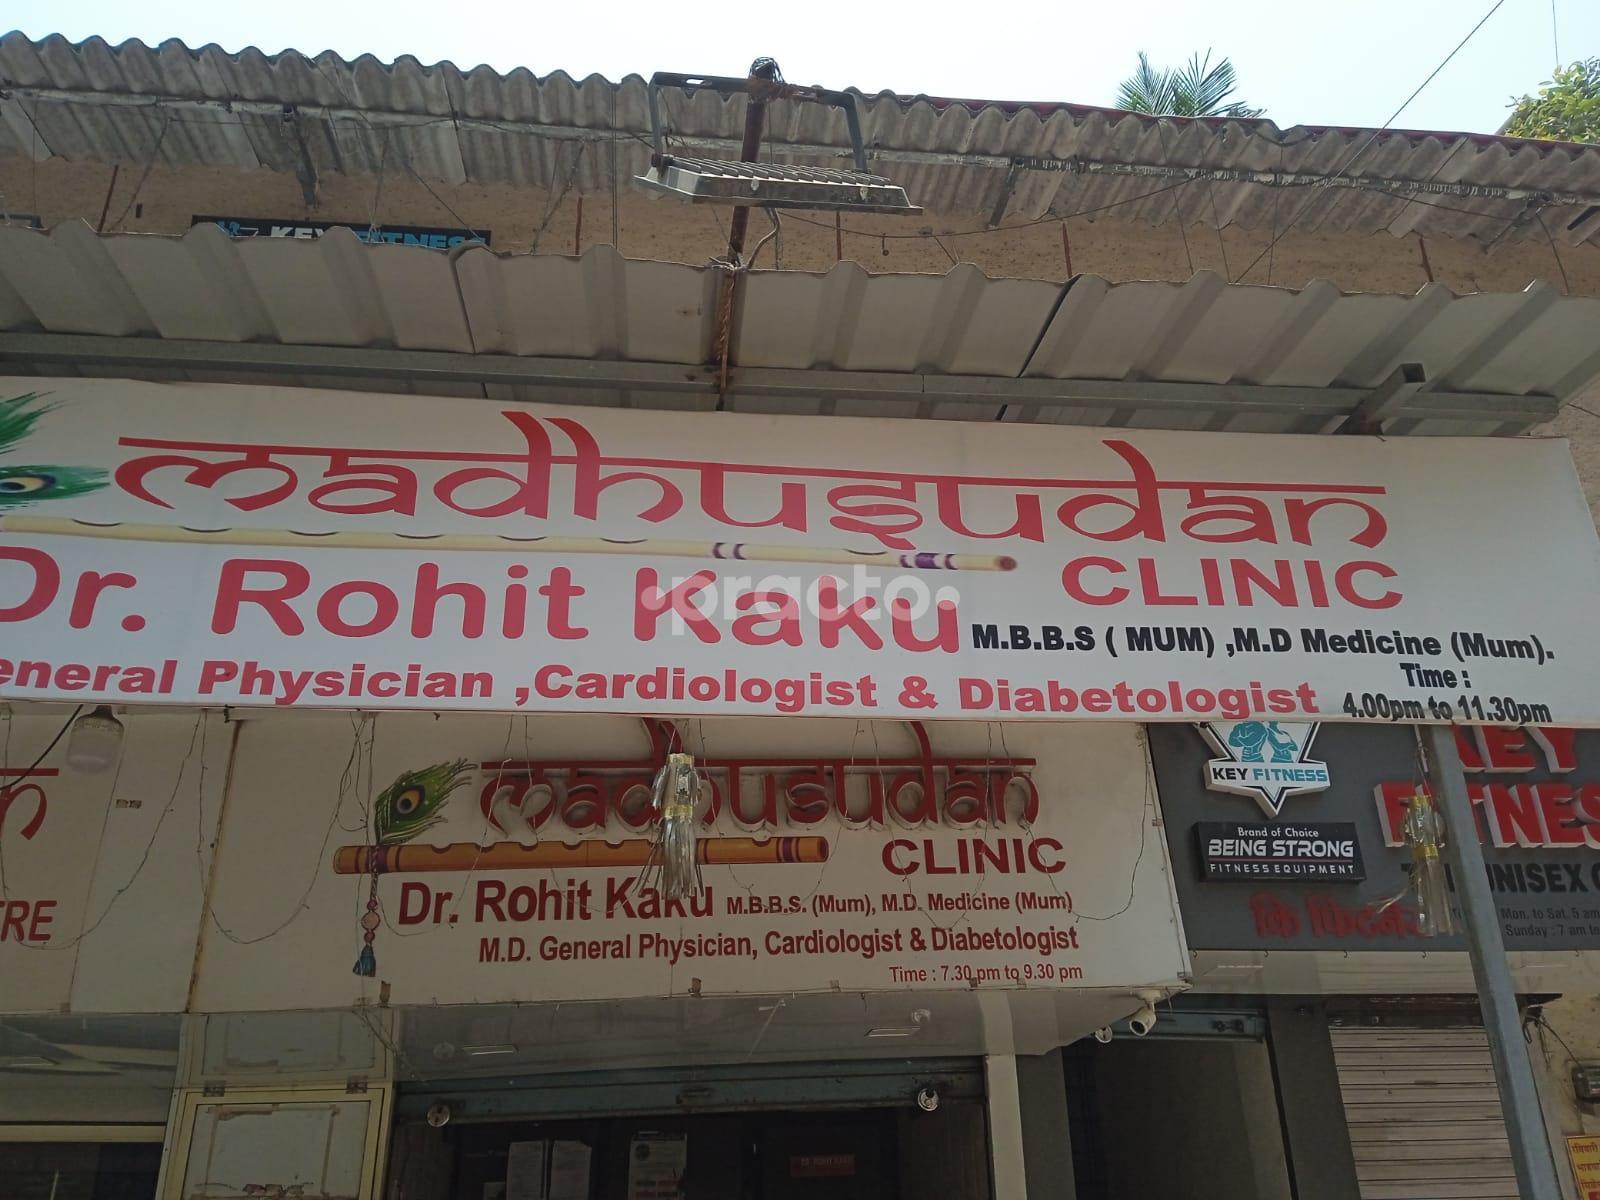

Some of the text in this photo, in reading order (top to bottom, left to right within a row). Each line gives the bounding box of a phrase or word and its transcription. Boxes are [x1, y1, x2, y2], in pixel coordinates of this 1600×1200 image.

[115, 411, 1387, 549] madhusudan
[0, 545, 960, 653] Dr. Rohit Kaku
[1062, 556, 1403, 610] CLINIC
[972, 624, 1095, 650] M.B.B.S
[1300, 628, 1442, 656] Medicine
[1450, 631, 1555, 665] (Mum).
[198, 660, 493, 705] Physician
[898, 676, 938, 709] &
[958, 677, 1320, 720] Diabetologist
[1400, 663, 1457, 688] Time
[1342, 692, 1553, 725] 4.00pm to 11.30pm
[1212, 768, 1328, 782] KEY FITNESS
[1208, 839, 1354, 857] BEING STRONG
[1238, 827, 1319, 838] Brand of Choice
[881, 836, 1067, 875] CLINIC
[1210, 863, 1354, 874] FITNESS EQUIPMENT
[398, 881, 458, 925] Dr.
[474, 878, 592, 923] Rohit
[726, 891, 1073, 917] M.B.B.S. (Mum), M.D. Medicine (Mum)
[1532, 908, 1544, 920] to
[1571, 908, 1580, 920] 5
[0, 900, 57, 942] RE
[1504, 924, 1547, 938] Sunday
[1557, 924, 1565, 936] 7
[1569, 926, 1587, 937] am
[479, 925, 1079, 966] M.D. General Physician, Cardiologist & Diabetologist
[889, 966, 928, 982] Time
[941, 965, 972, 982] 7.30
[977, 968, 1001, 984] pm
[1005, 965, 1020, 980] to
[1024, 963, 1055, 980] 9.30
[1060, 967, 1083, 983] pm
